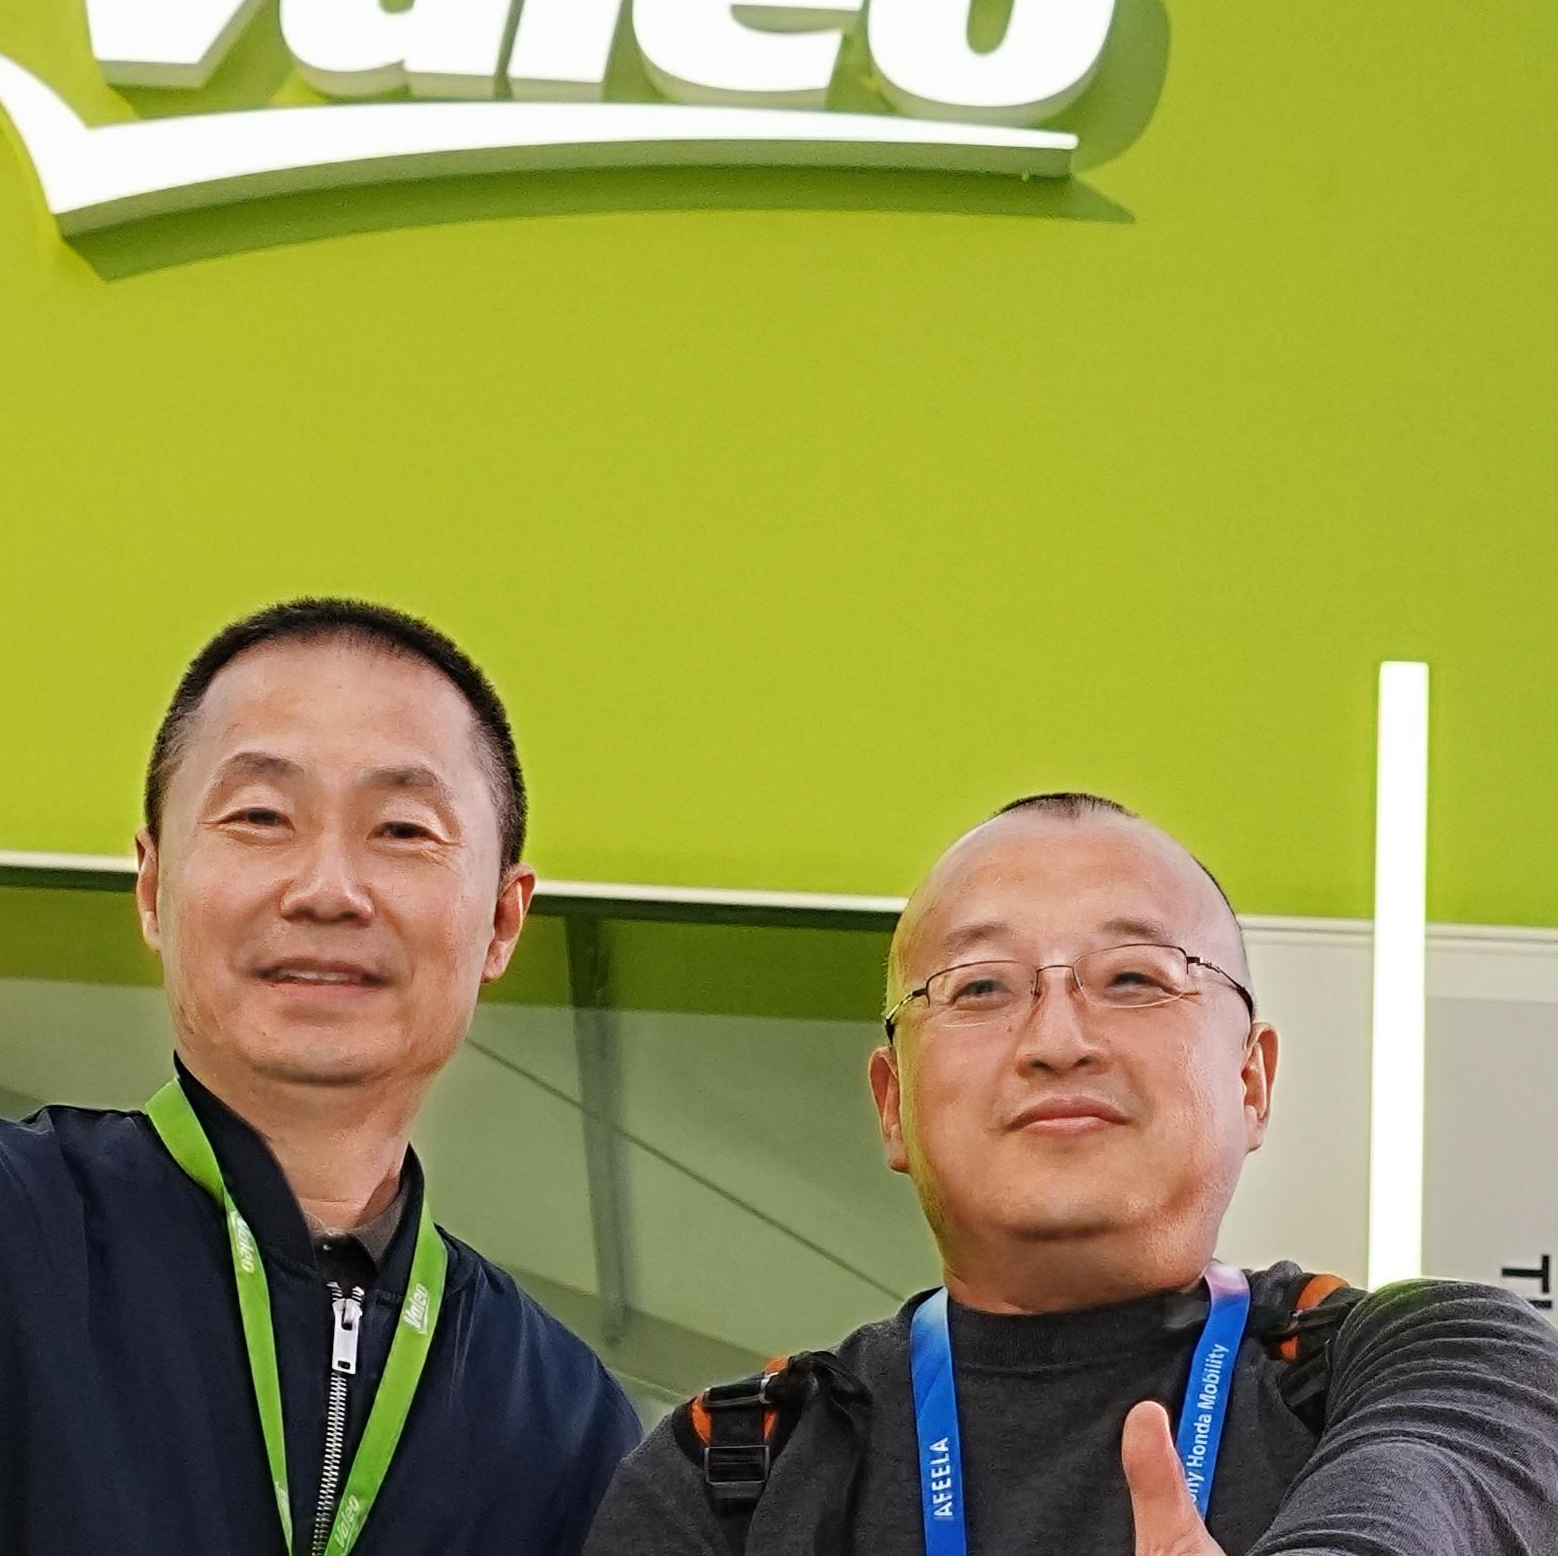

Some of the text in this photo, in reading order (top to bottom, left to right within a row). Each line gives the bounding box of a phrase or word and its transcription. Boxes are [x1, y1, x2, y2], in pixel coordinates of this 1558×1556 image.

[403, 1283, 429, 1333] Valeo
[1196, 1343, 1230, 1410] Mobility
[1186, 1414, 1213, 1467] Honda
[929, 1436, 954, 1517] AFEELA
